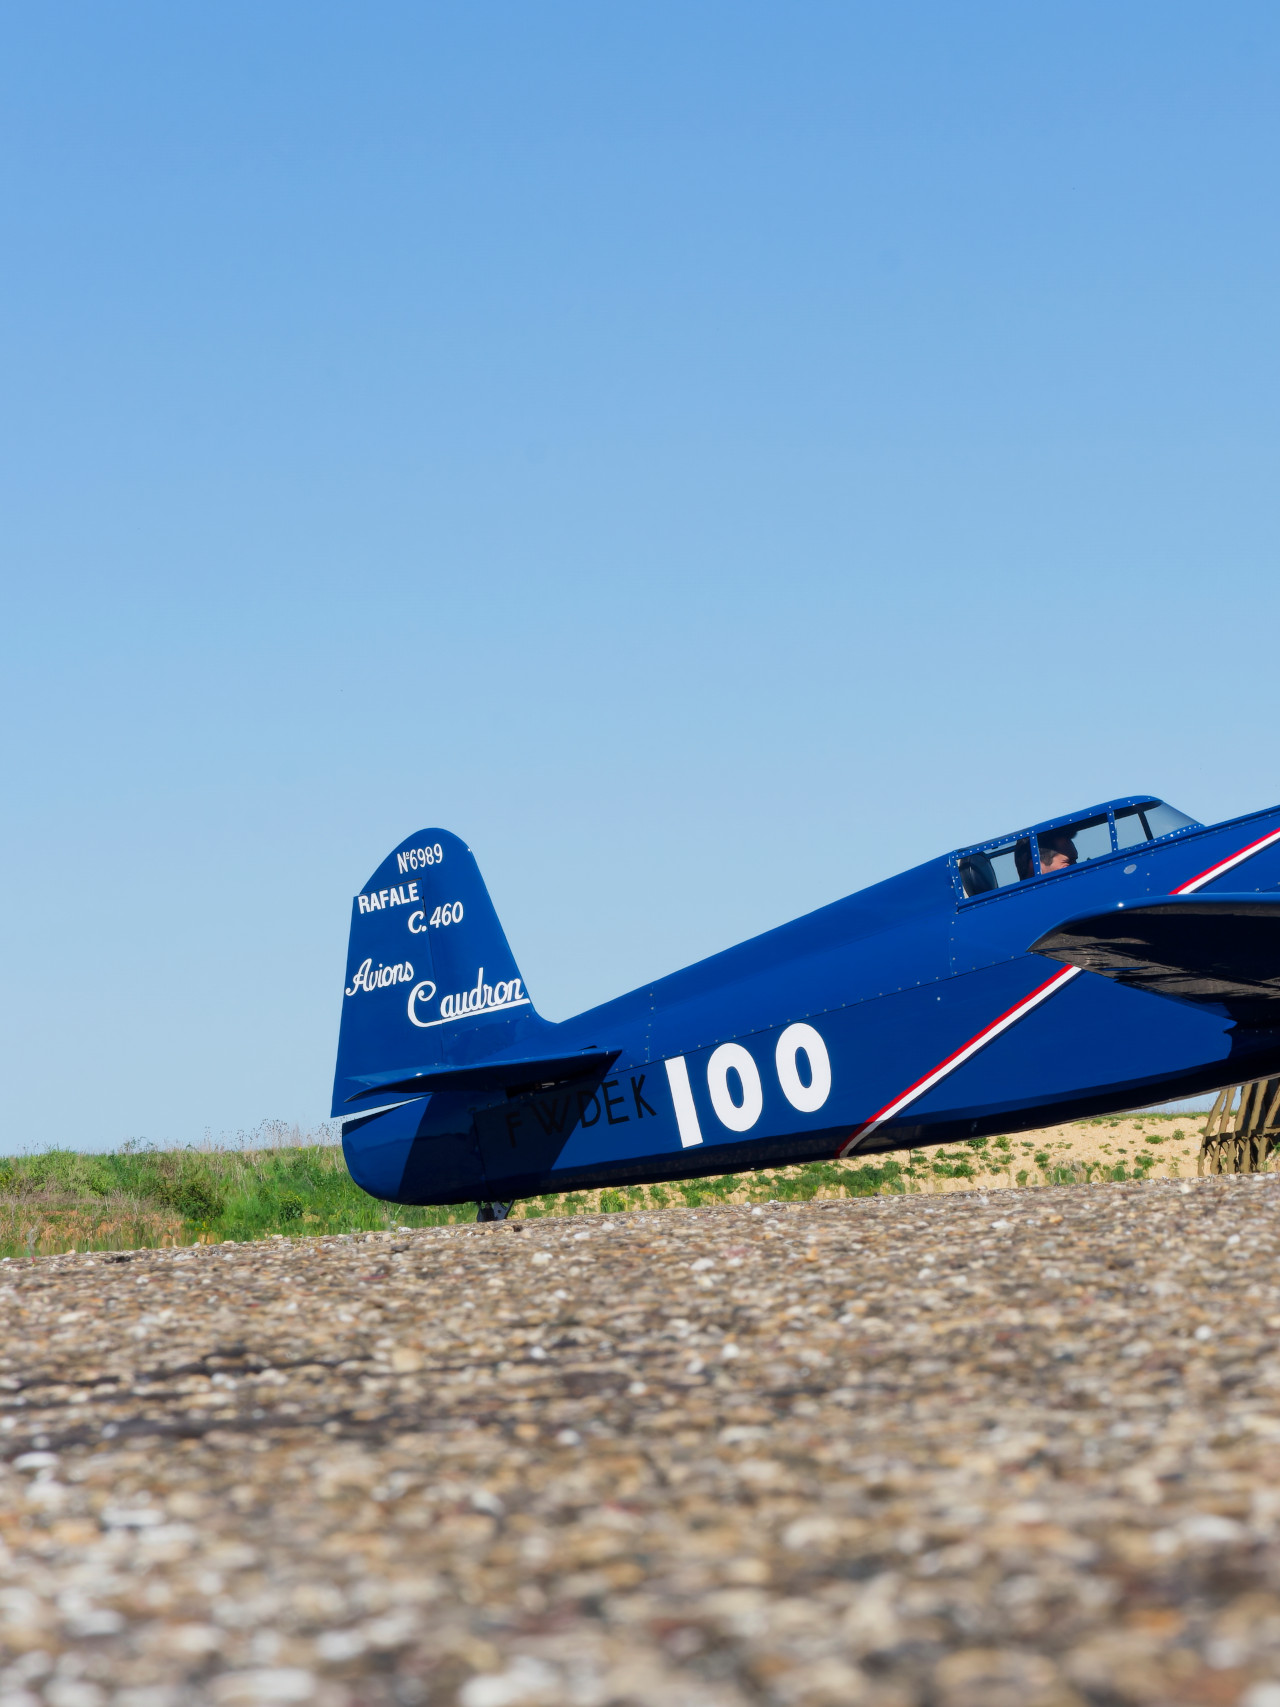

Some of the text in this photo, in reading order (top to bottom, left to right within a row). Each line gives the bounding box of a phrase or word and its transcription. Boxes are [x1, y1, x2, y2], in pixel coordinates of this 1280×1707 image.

[358, 882, 420, 914] RAFALE
[345, 958, 414, 996] Avions
[407, 967, 531, 1027] Caudron
[664, 1022, 832, 1148] 100
